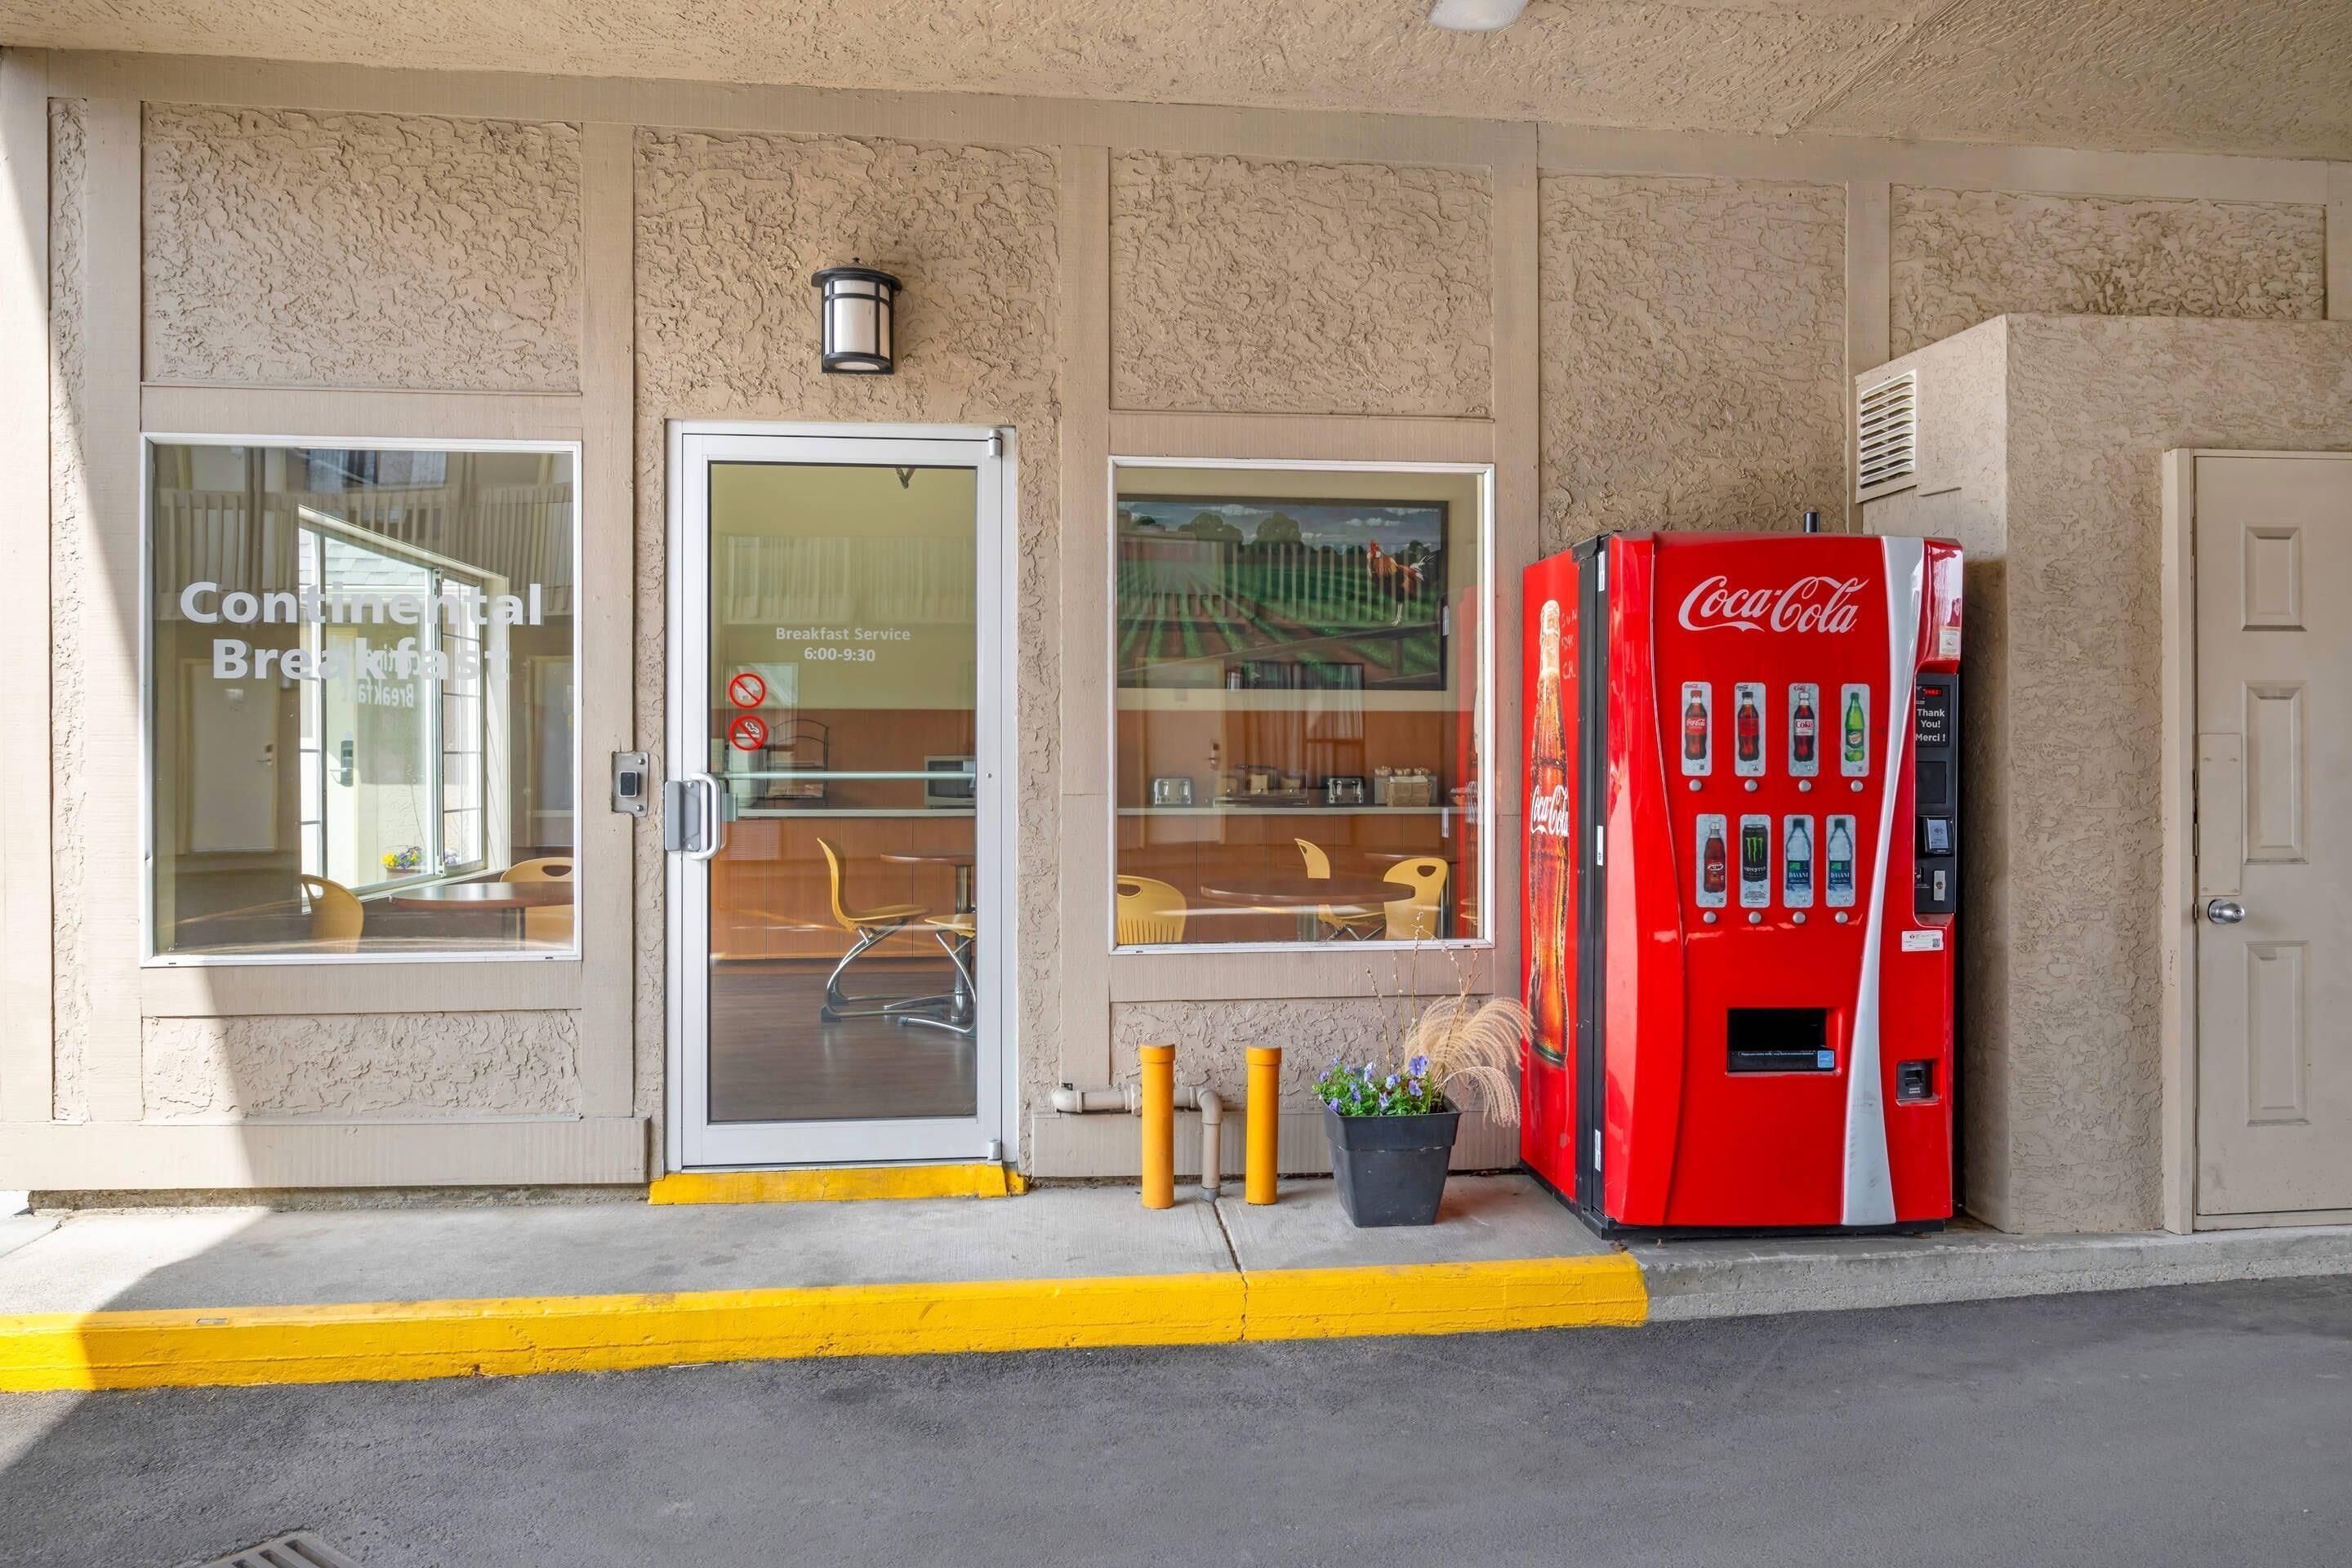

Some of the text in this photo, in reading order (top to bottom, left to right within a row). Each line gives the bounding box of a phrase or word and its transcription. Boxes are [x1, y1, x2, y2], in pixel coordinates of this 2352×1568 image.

[180, 581, 541, 626] Continental
[1678, 575, 1869, 633] Coca-Cola
[776, 627, 911, 640] Breakfast Service
[213, 637, 510, 679] Breakfast
[804, 647, 876, 662] 6:00-9:30
[1917, 708, 1945, 717] Thank
[1921, 719, 1941, 728] You!
[1916, 733, 1940, 742] Merci
[1530, 784, 1569, 838] Coca-Cola
